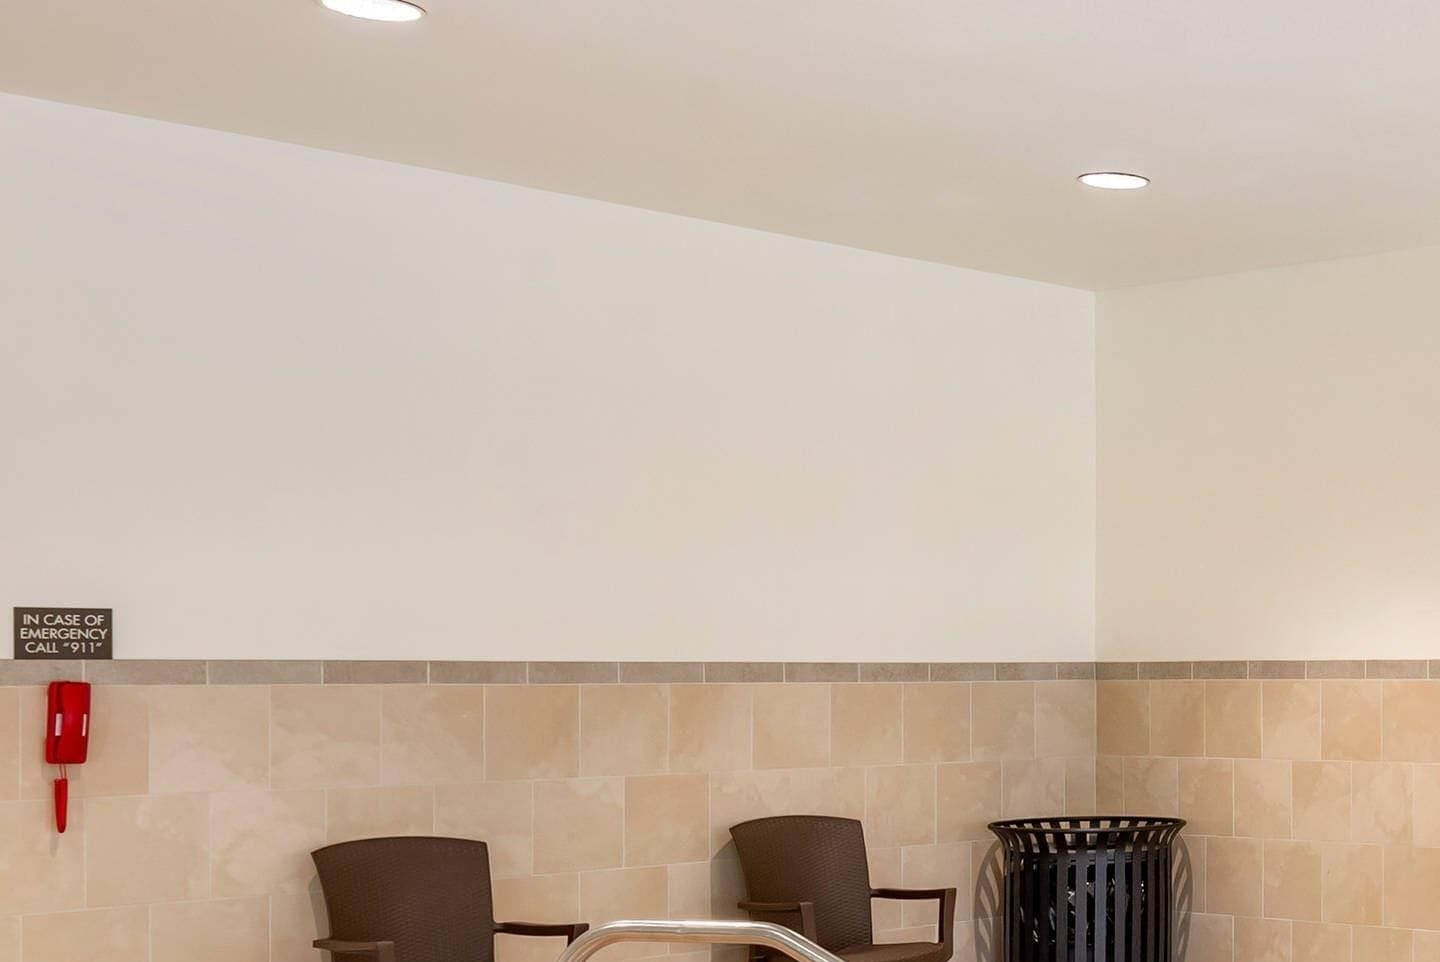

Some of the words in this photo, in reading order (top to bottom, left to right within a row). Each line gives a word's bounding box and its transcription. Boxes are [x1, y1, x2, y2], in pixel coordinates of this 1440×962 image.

[23, 613, 40, 625] IN
[43, 613, 81, 626] CASE
[84, 614, 105, 626] OF
[20, 627, 108, 640] EMERGENCY
[25, 641, 59, 653] CALL
